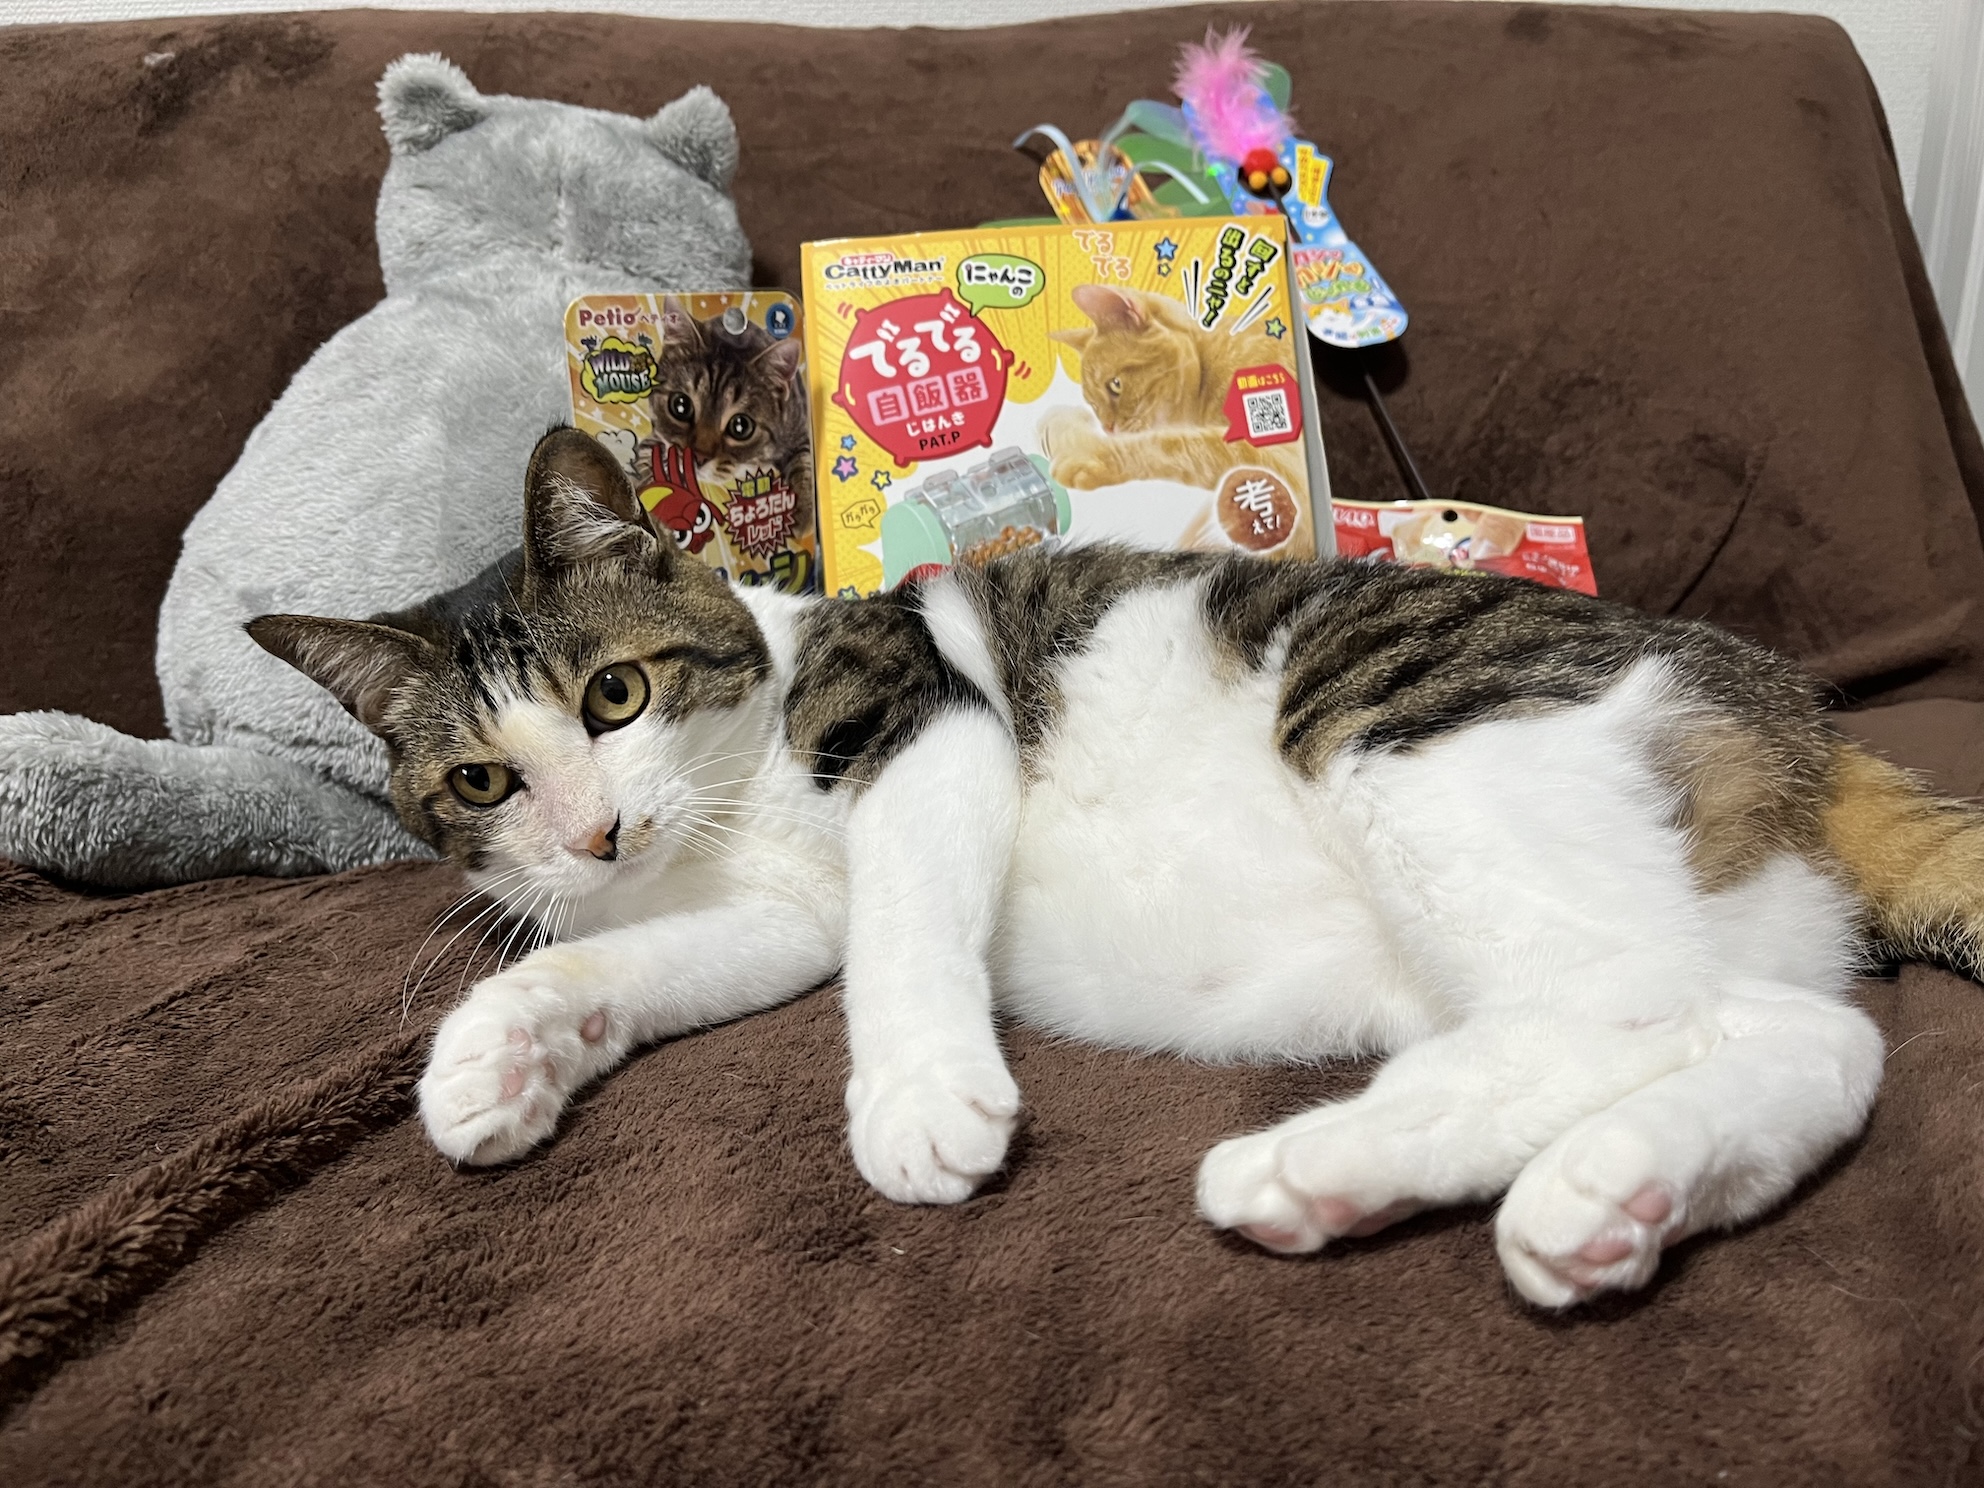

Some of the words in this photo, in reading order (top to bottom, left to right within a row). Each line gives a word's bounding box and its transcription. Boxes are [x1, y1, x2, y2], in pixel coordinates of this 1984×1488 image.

[825, 260, 941, 280] CattyMan
[579, 307, 641, 326] Petio
[849, 303, 982, 378] でるでる
[588, 349, 631, 376] WILD
[594, 369, 651, 398] MOUSE
[870, 369, 987, 424] 自飯器
[906, 411, 965, 437] じはんき
[918, 431, 961, 451] PAT.P
